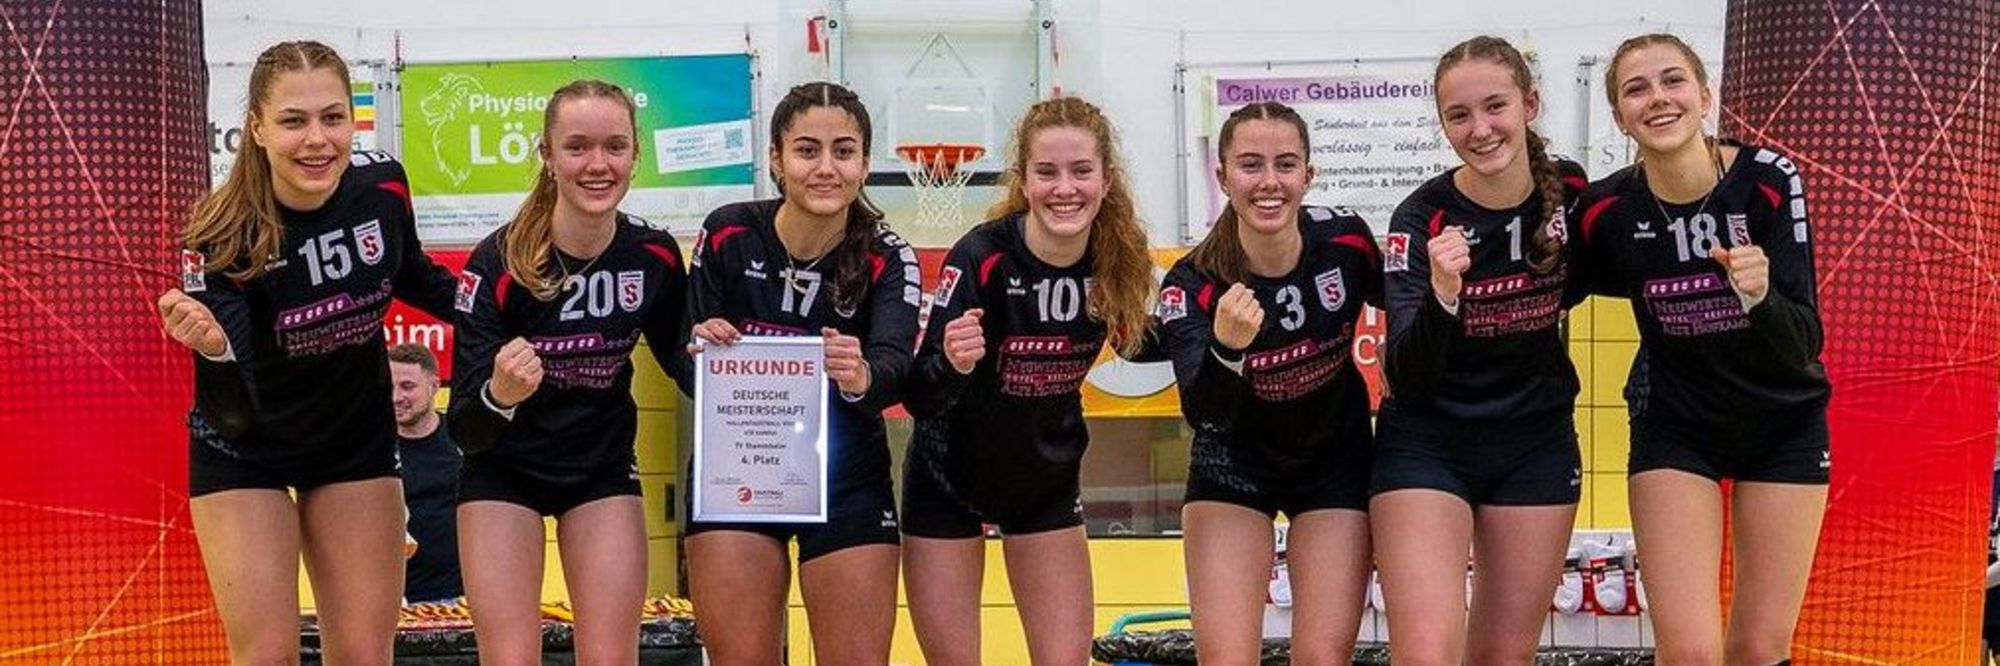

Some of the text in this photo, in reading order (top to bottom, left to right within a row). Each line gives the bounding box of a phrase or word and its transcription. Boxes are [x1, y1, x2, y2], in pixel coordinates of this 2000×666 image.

[1227, 84, 1299, 102] Calwer
[1394, 136, 1442, 155] einfach
[1338, 179, 1378, 190] Grund-
[1381, 178, 1389, 188] &
[1505, 215, 1522, 260] 1
[1667, 213, 1720, 261] 18
[298, 228, 352, 286] 15
[560, 270, 614, 321] 20
[779, 267, 821, 317] 17
[1032, 277, 1080, 322] 10
[1275, 285, 1306, 331] 3
[709, 359, 815, 376] URKUNDE
[716, 404, 806, 416] MEISTERSCHAFT
[732, 389, 790, 401] DEUTSCHE
[741, 454, 781, 466] 4. Platz
